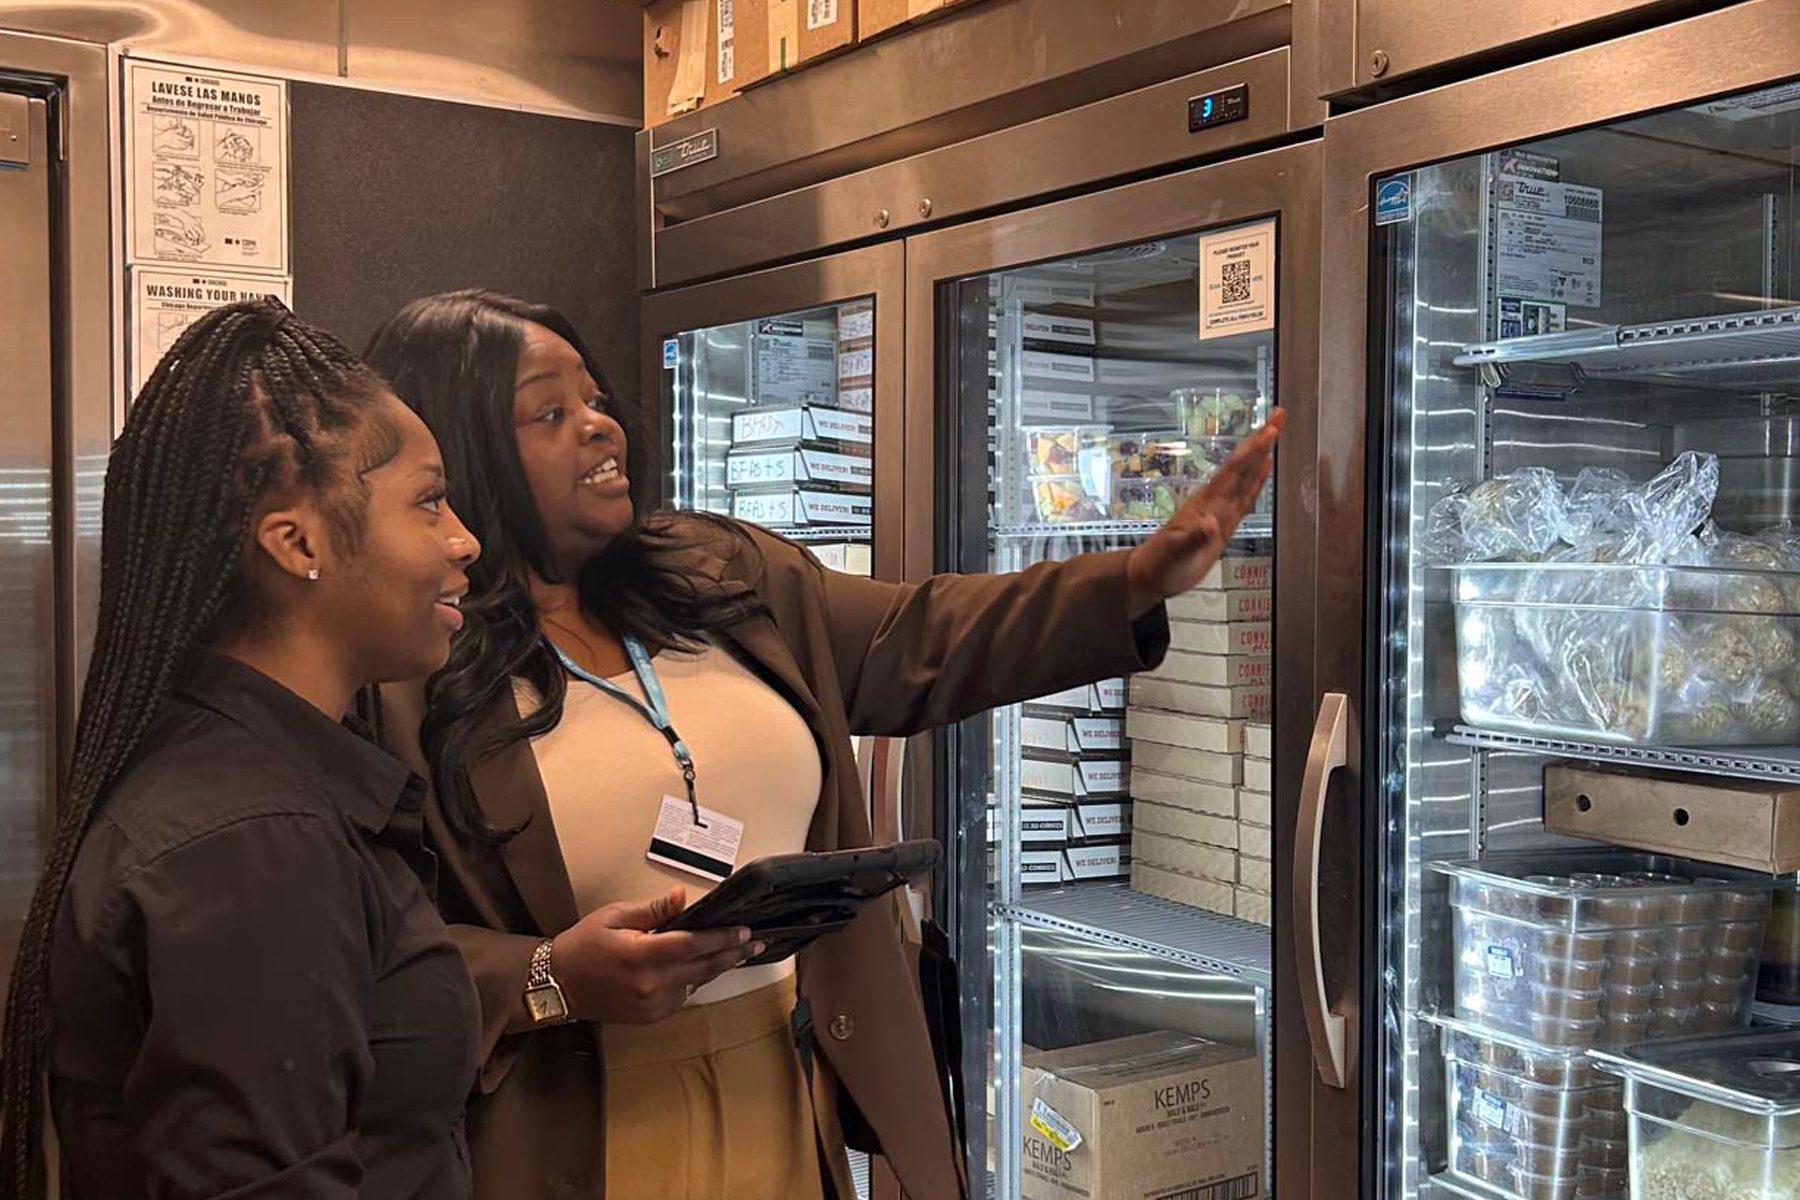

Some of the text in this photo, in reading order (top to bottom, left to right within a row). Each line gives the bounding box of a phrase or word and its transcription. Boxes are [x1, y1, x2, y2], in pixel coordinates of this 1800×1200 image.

[152, 82, 261, 106] LAVESE LAS MANOS
[152, 96, 174, 106] Antes
[187, 100, 220, 111] Regresar
[230, 105, 261, 116] Trabajar
[1203, 98, 1211, 117] 3
[677, 139, 711, 158] True
[1516, 182, 1546, 196] True
[147, 285, 202, 300] WASHING
[206, 289, 236, 301] YOUR
[1154, 1080, 1210, 1110] KEMPS
[1023, 1135, 1072, 1171] KEMPS
